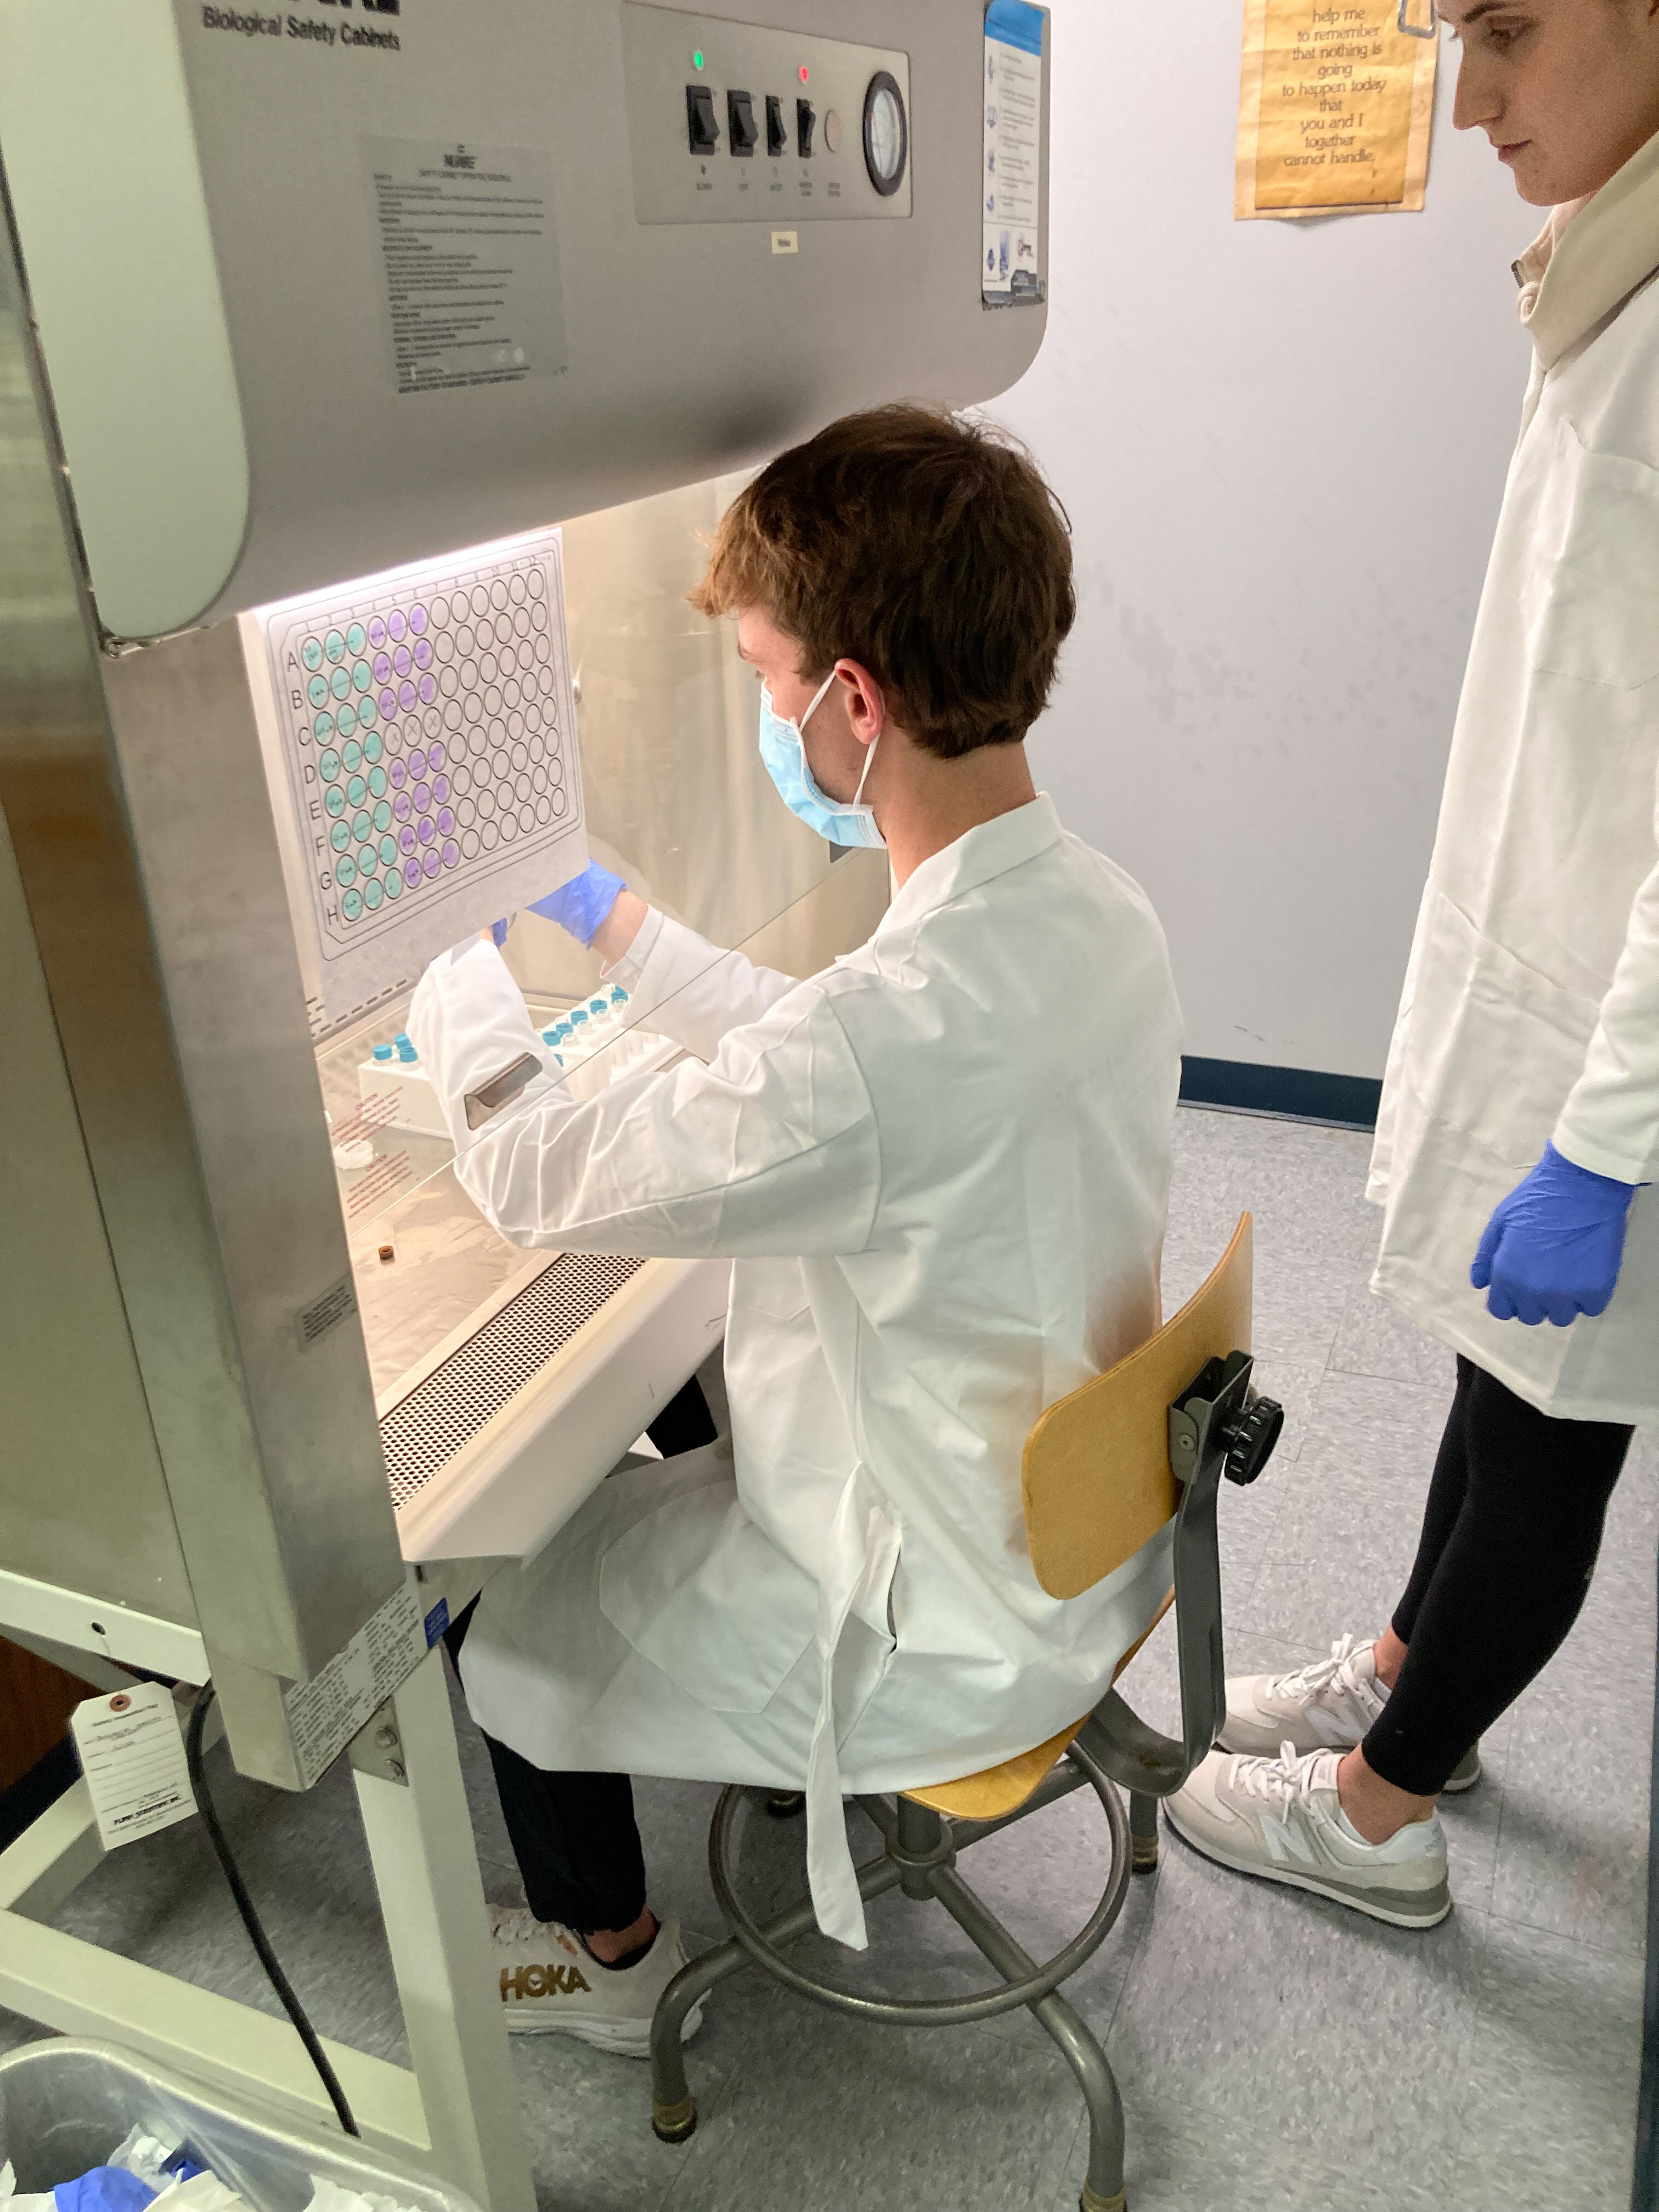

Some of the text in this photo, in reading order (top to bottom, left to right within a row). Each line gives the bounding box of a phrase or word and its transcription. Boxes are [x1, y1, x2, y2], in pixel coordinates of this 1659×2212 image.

[1312, 7, 1365, 25] help me
[202, 5, 283, 37] Biological
[286, 15, 336, 47] Safety
[341, 21, 402, 52] Cabinets
[1298, 24, 1381, 42] to remember
[1293, 41, 1383, 60] that nothing is
[1318, 63, 1353, 80] going
[1283, 76, 1387, 97] to happen today
[1319, 98, 1342, 112] that
[1300, 112, 1363, 134] you and I
[1305, 133, 1356, 150] together
[1284, 154, 1325, 166] cannot
[492, 566, 500, 576] 10
[511, 561, 518, 571] 11
[529, 555, 535, 567] 12
[287, 652, 299, 672] A
[292, 690, 302, 709] B
[298, 727, 311, 746] C
[304, 765, 315, 785] D
[310, 800, 321, 820] E
[315, 836, 325, 856] F
[320, 872, 331, 890] G
[327, 905, 338, 926] H
[499, 1964, 592, 2002] HOKA
